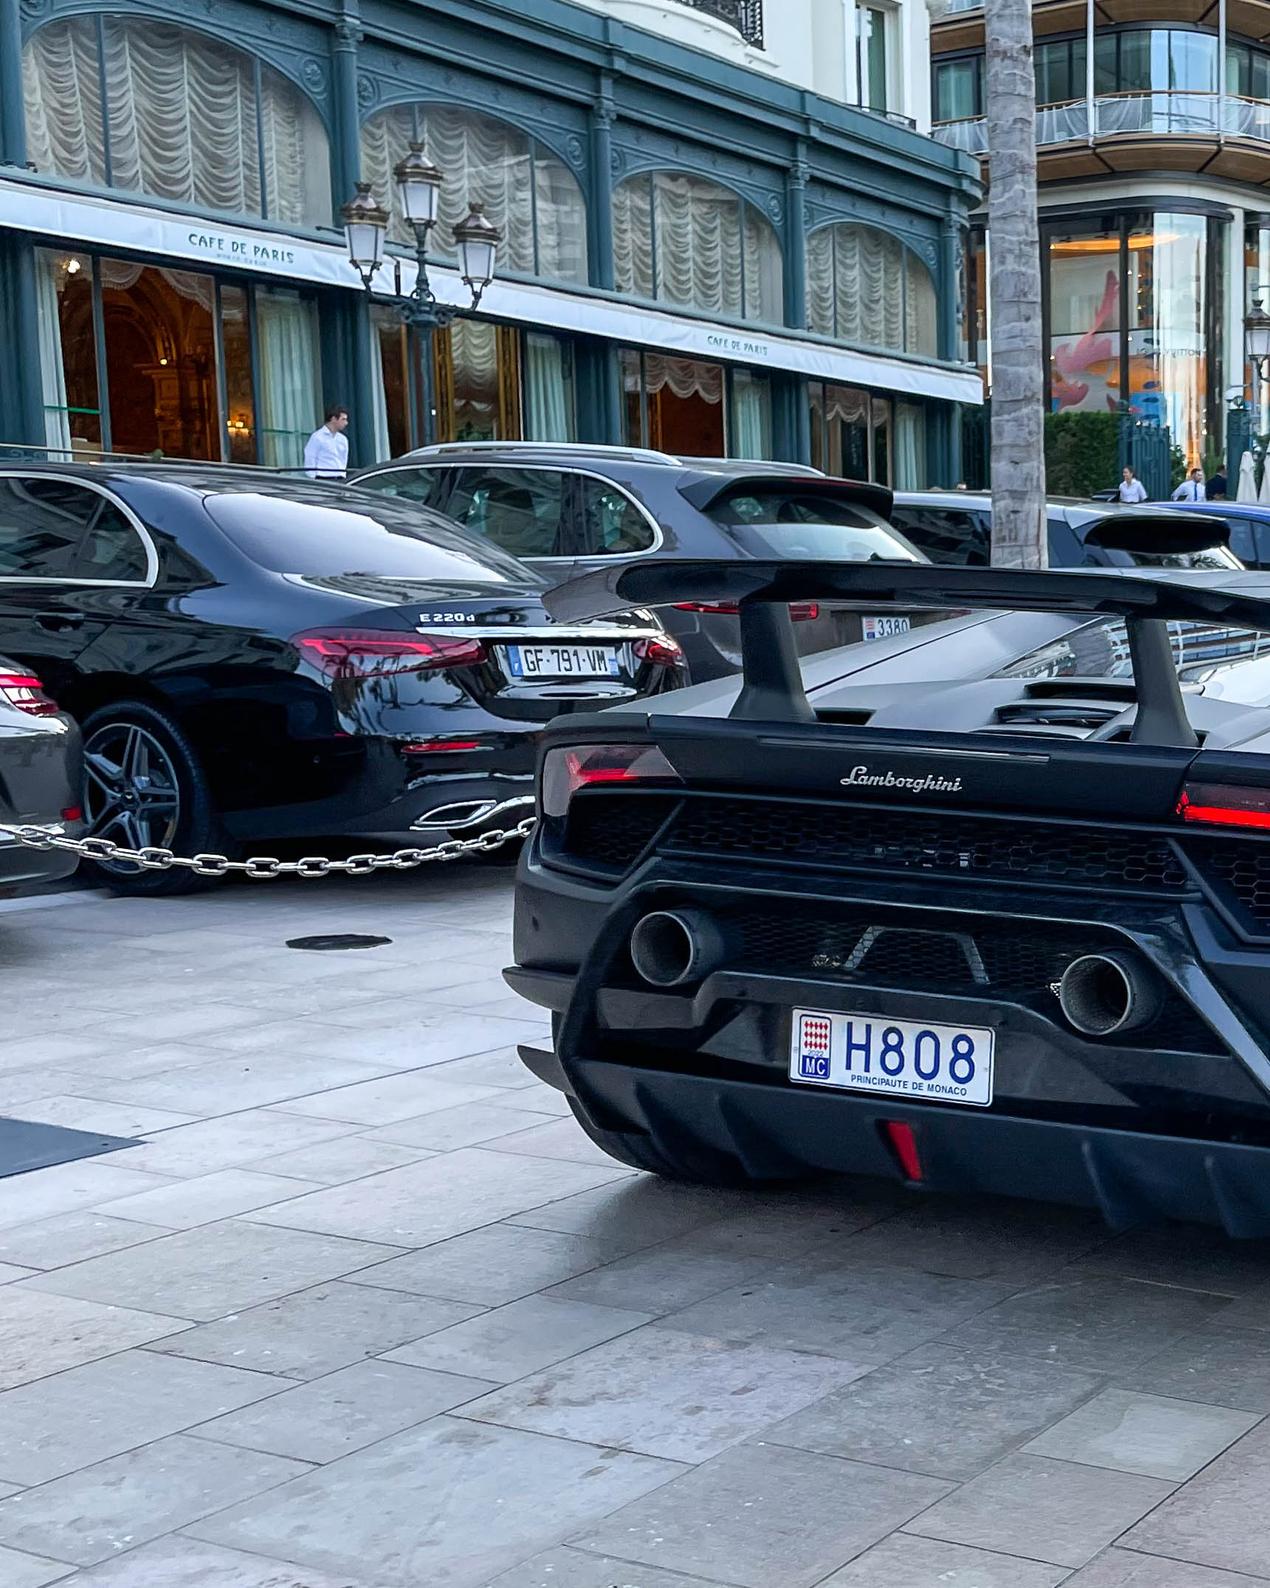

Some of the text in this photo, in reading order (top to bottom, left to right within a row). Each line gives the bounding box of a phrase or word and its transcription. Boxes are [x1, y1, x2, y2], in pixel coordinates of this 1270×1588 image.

[188, 233, 225, 250] CAFE
[231, 241, 247, 255] DE
[253, 245, 294, 264] PARIS
[707, 335, 728, 349] CAFE
[731, 340, 741, 351] DE
[743, 342, 768, 356] PARIS
[419, 614, 431, 622] E
[878, 619, 908, 636] 3380
[524, 649, 608, 672] GF-791-VM
[840, 765, 963, 793] Lamborghini
[845, 1021, 975, 1085] H808
[805, 1058, 826, 1075] MC
[850, 1074, 967, 1096] PRINCIPAUTE DE MONACO
